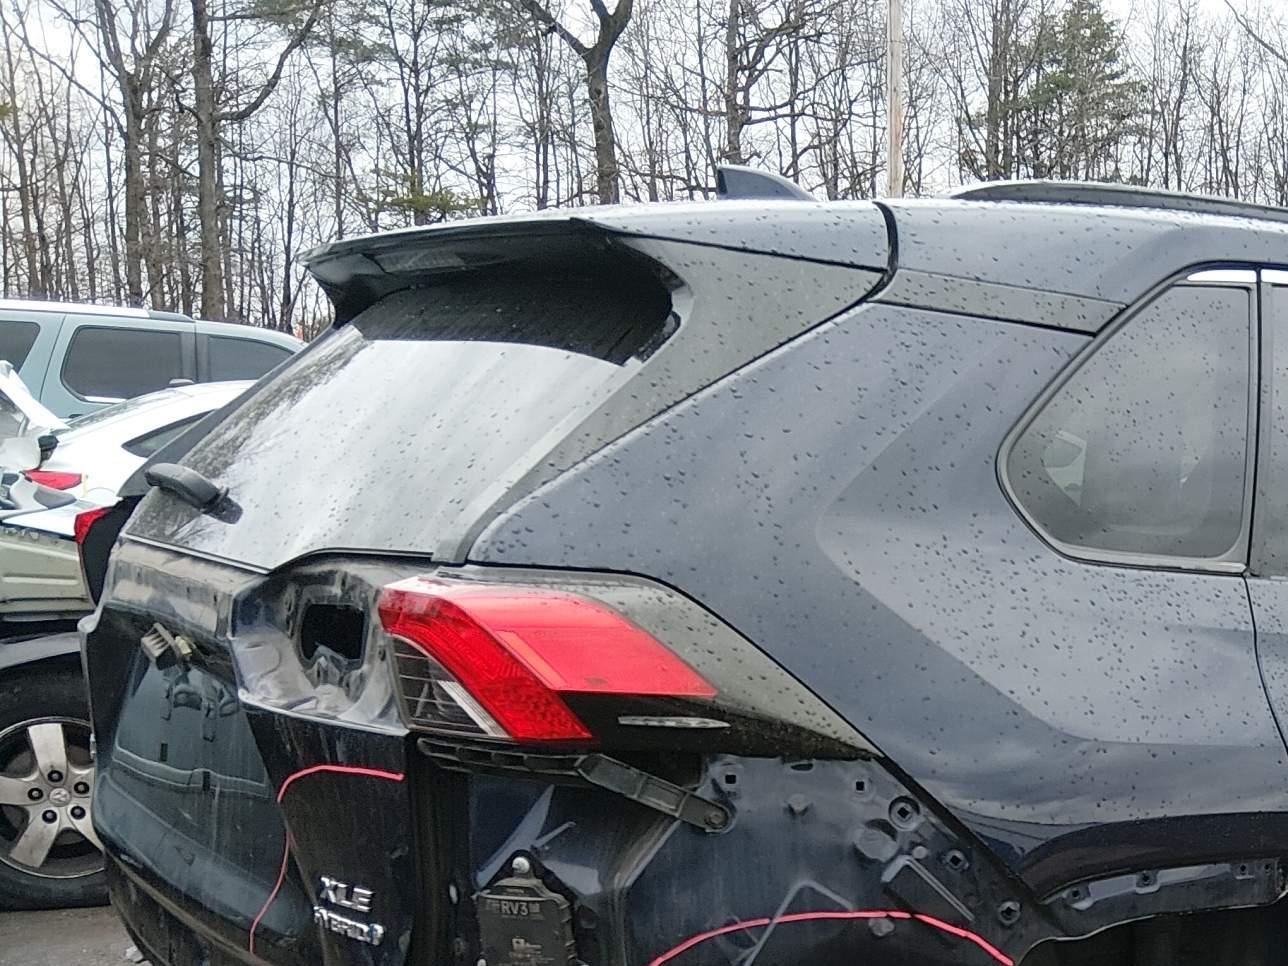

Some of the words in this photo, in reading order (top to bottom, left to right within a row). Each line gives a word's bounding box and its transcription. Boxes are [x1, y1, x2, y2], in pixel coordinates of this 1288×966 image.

[320, 876, 373, 913] XLE
[501, 901, 528, 915] RV3
[313, 906, 371, 943] HYBRID
